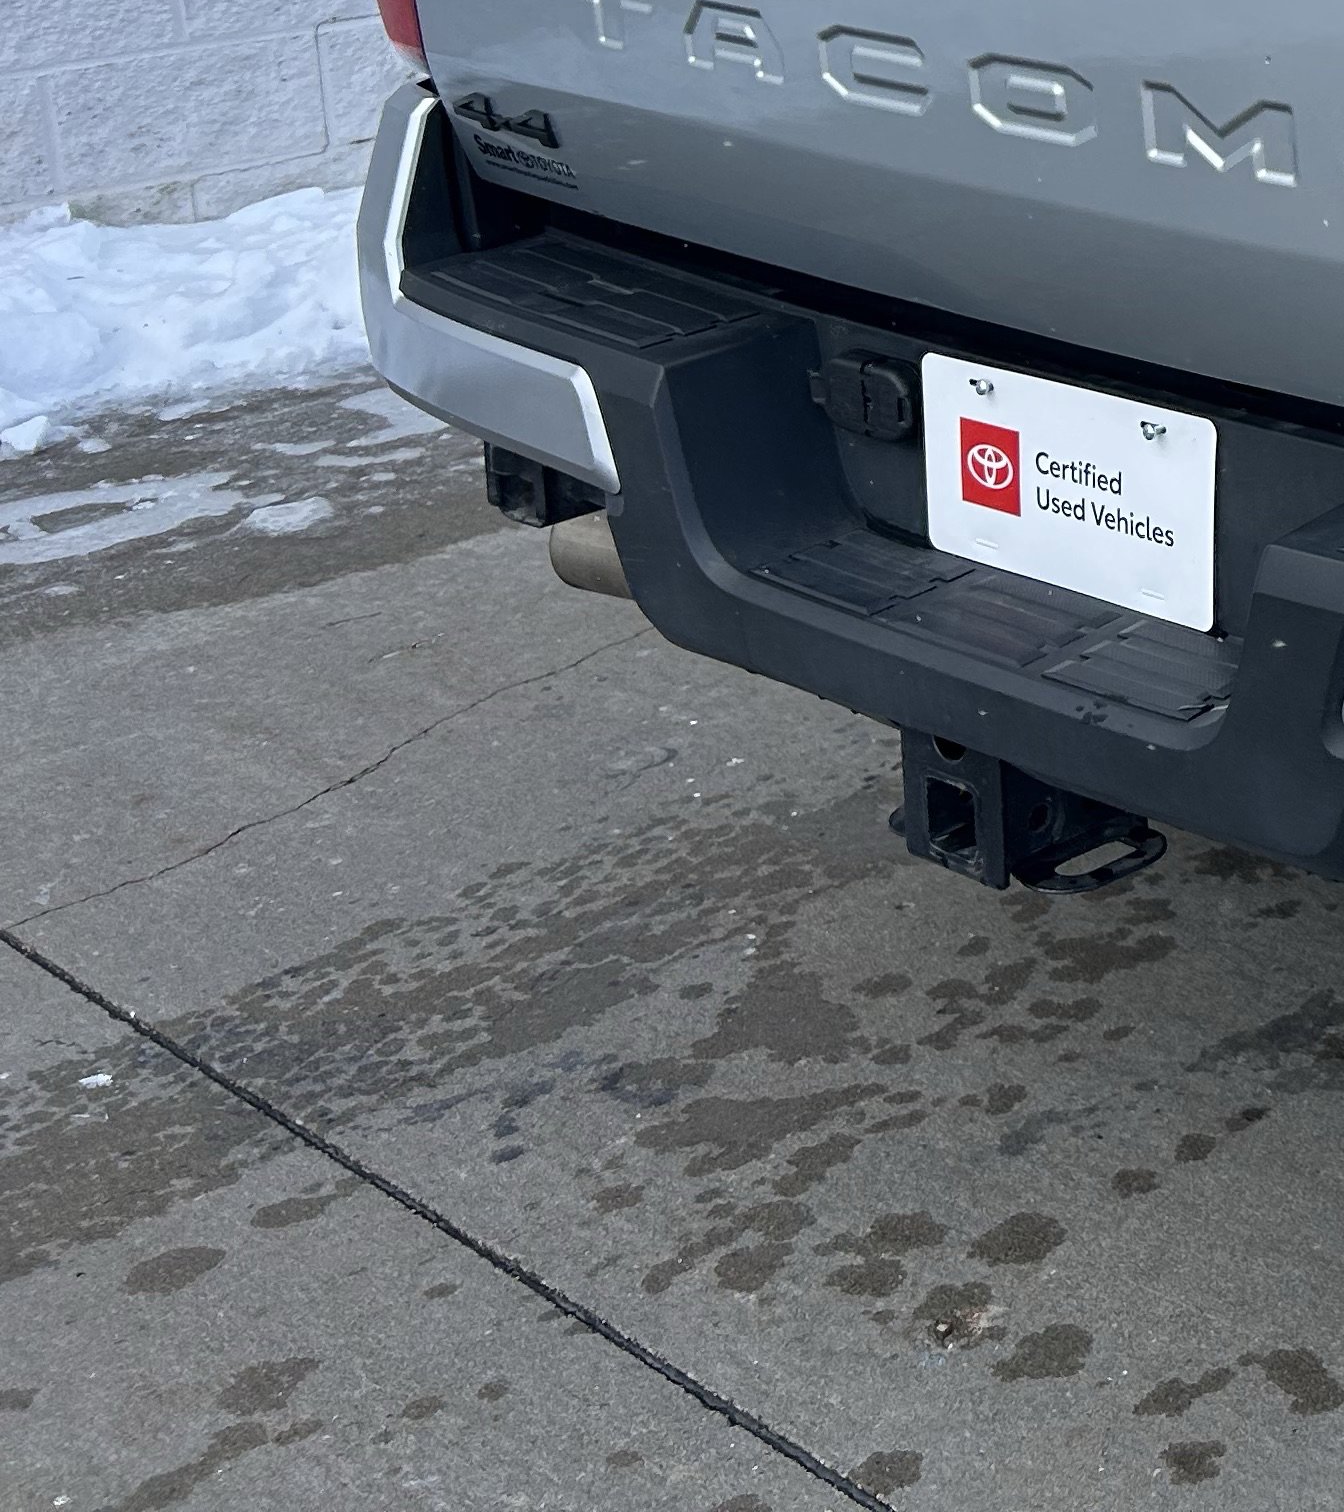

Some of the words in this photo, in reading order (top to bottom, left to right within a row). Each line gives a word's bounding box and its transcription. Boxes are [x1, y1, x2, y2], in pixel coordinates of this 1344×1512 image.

[473, 133, 519, 164] Smart
[1034, 450, 1123, 496] Certified
[1035, 485, 1086, 522] Used
[1090, 501, 1176, 548] Vehicles
